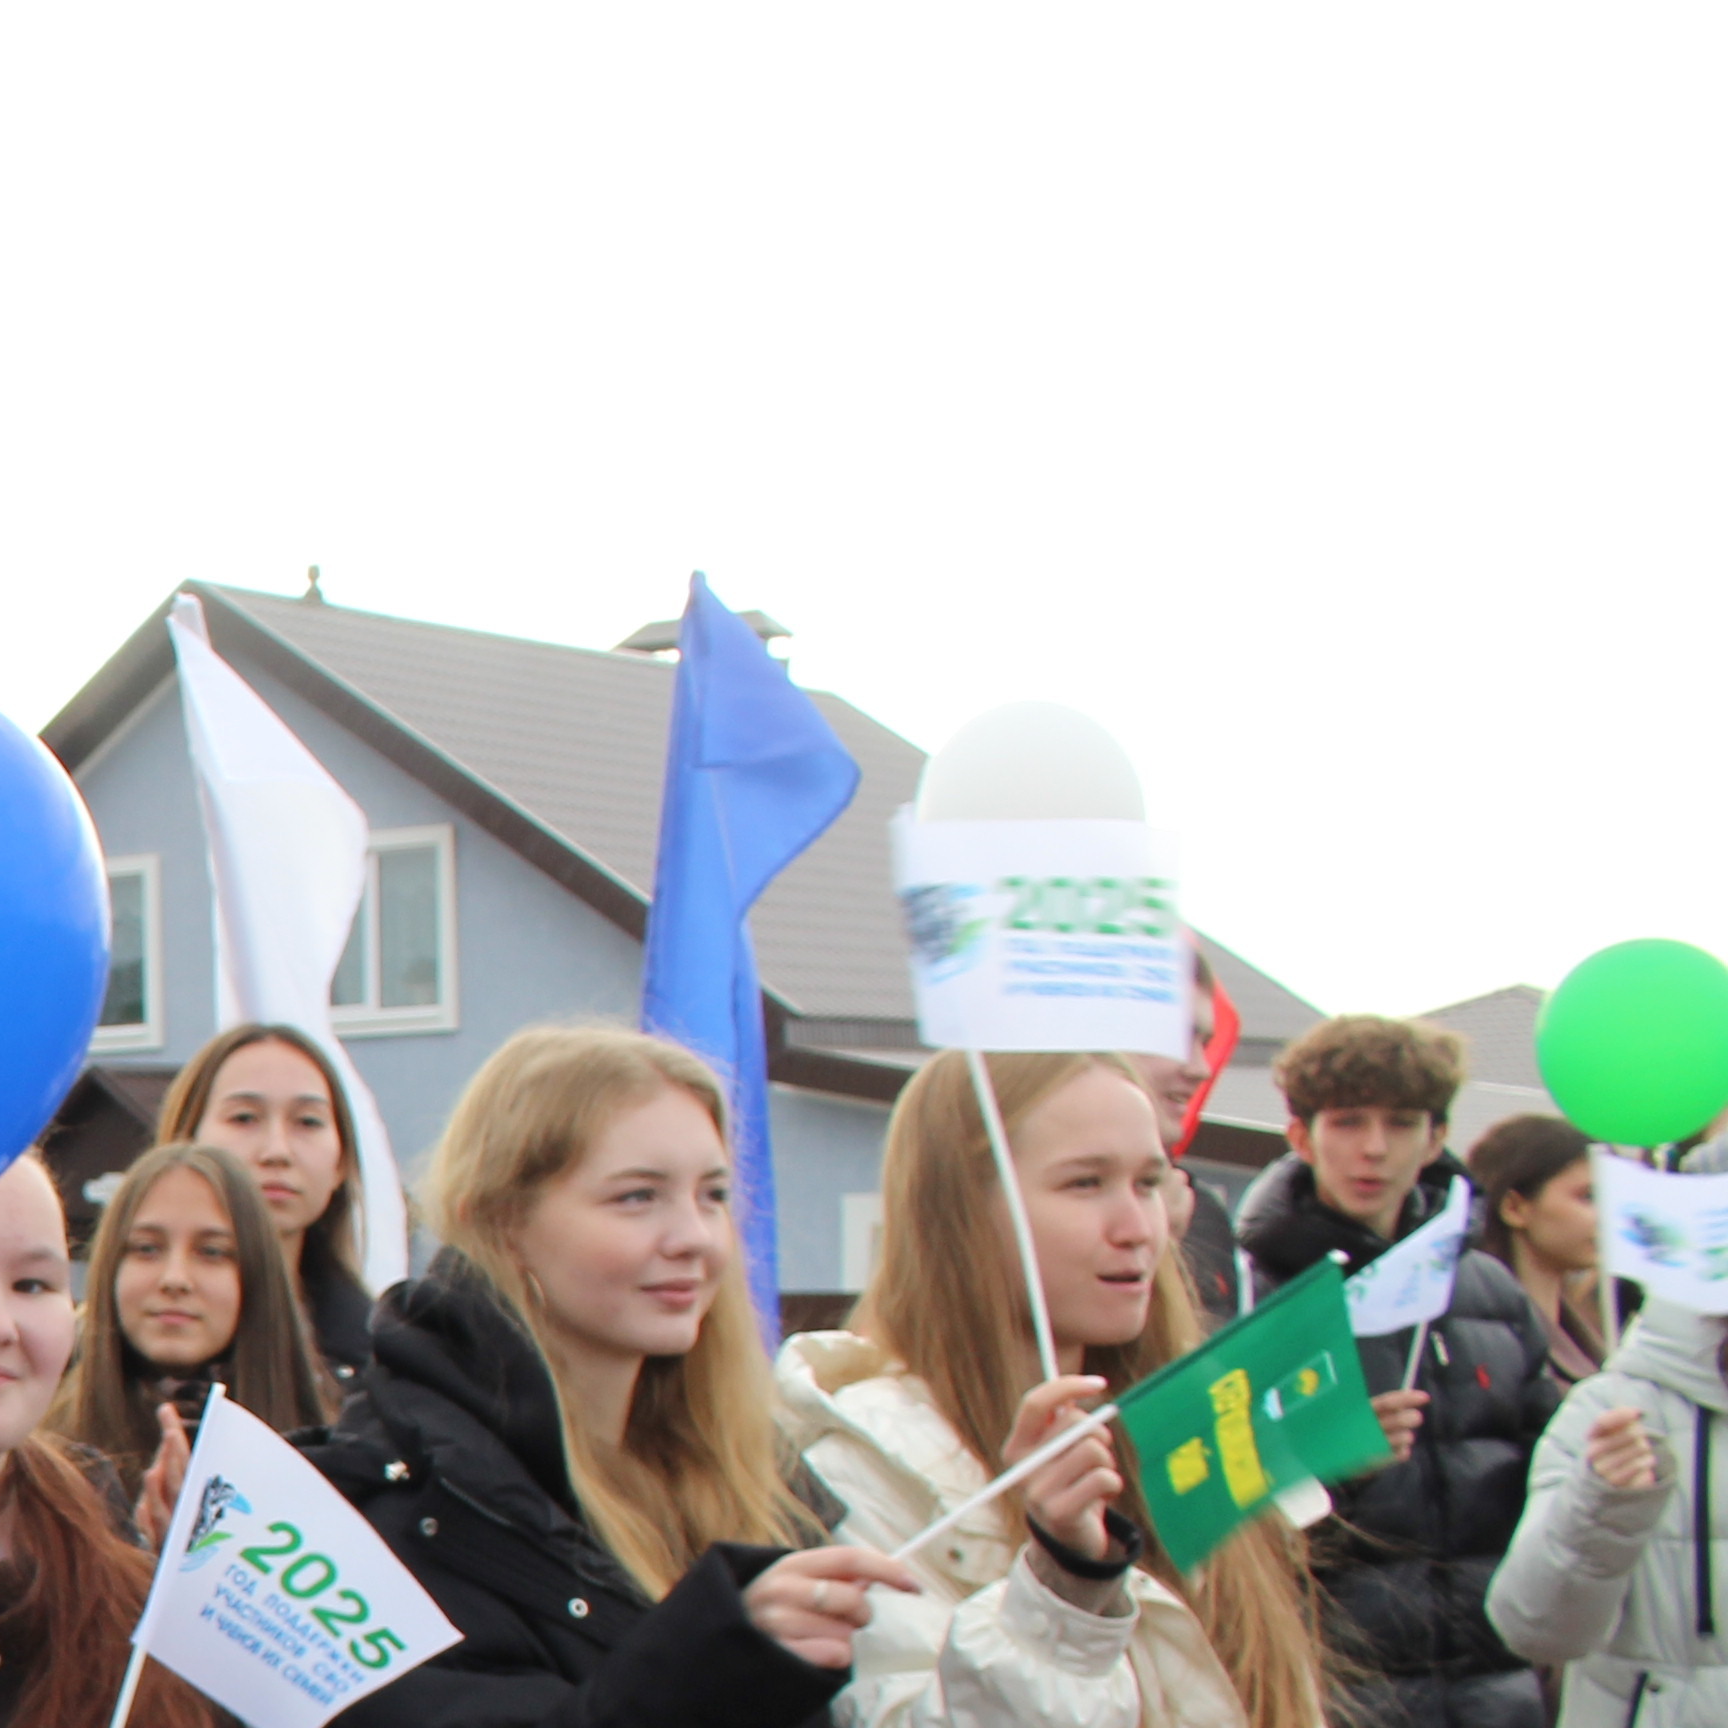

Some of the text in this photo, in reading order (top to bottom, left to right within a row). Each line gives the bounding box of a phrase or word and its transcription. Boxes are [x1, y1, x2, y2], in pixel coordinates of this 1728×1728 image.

[225, 1563, 258, 1597] ГОД
[239, 1521, 408, 1669] 2025
[200, 1603, 217, 1621] И
